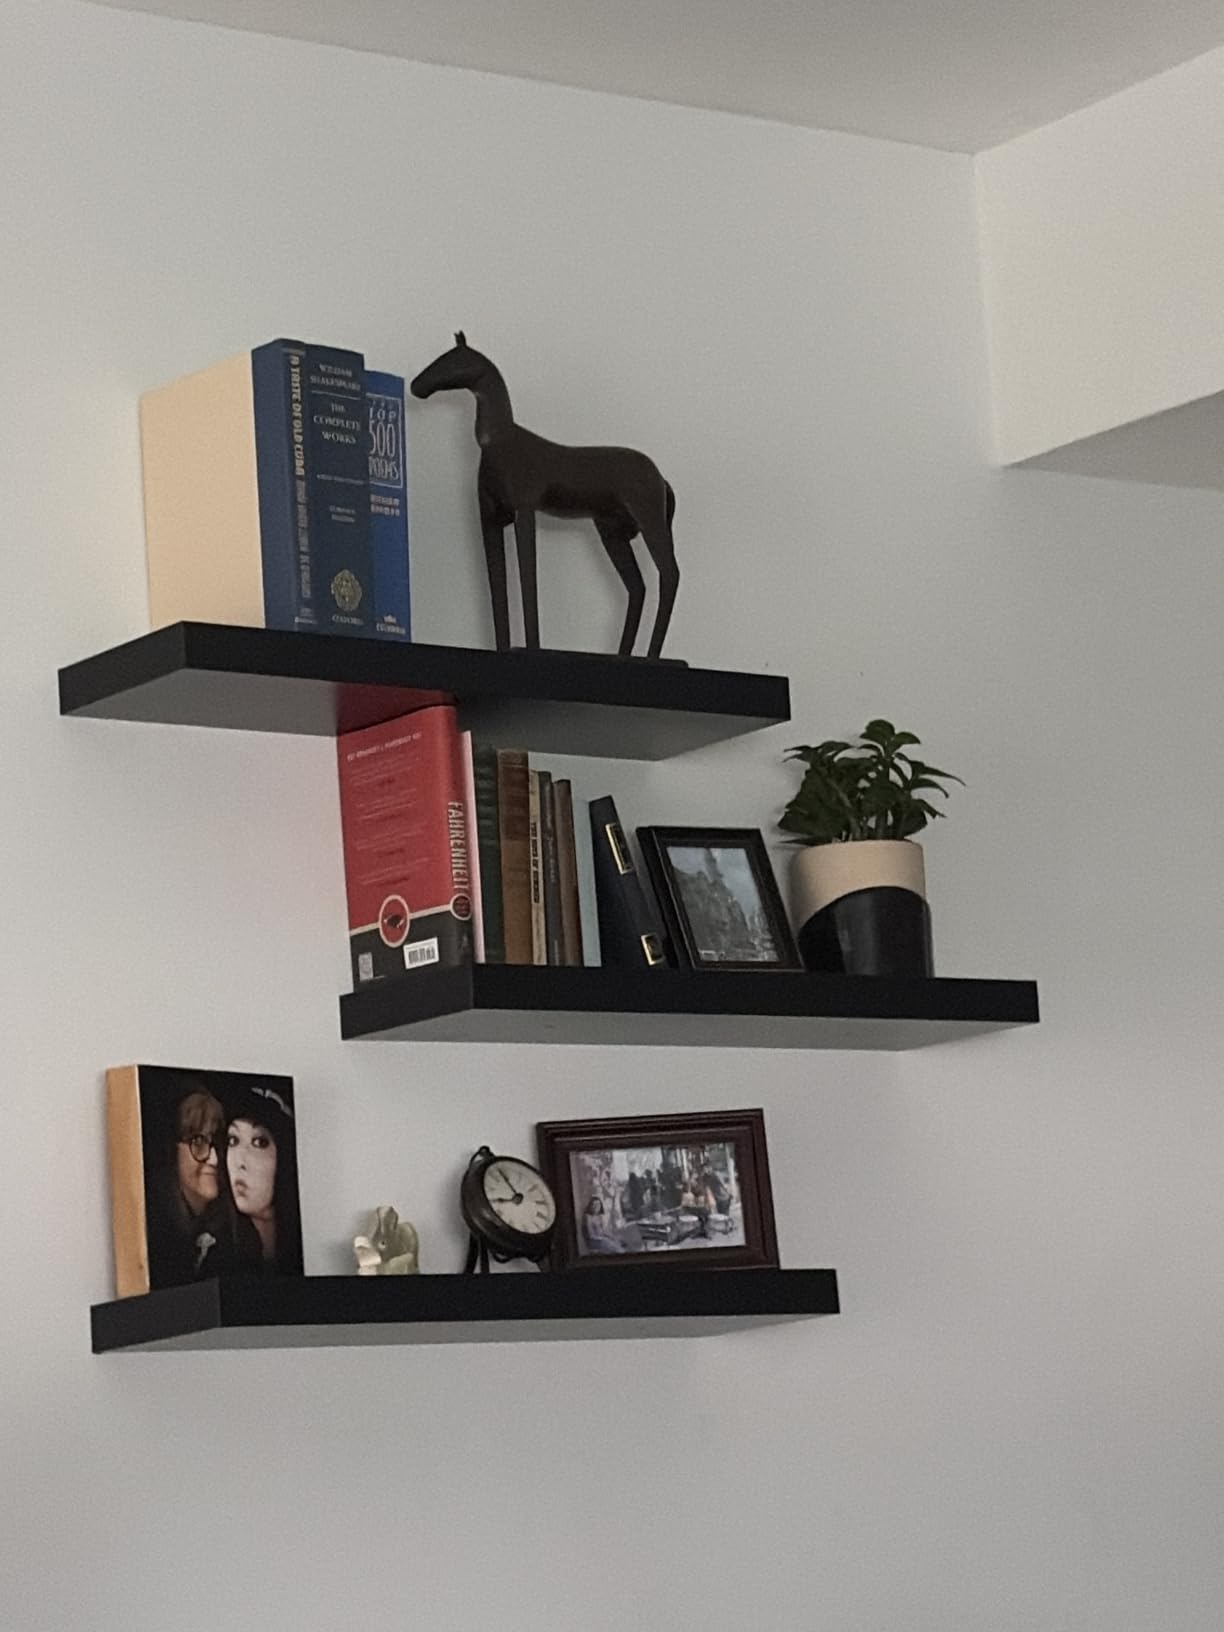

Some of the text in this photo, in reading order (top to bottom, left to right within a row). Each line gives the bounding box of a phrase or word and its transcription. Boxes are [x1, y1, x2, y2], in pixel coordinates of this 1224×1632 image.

[292, 403, 302, 417] OF
[293, 419, 303, 442] OLD
[313, 415, 361, 431] COMPLETE
[321, 431, 357, 444] WORKS
[368, 420, 396, 457] 500
[294, 444, 305, 475] CUBA
[447, 801, 469, 889] FAHRENHEIT
